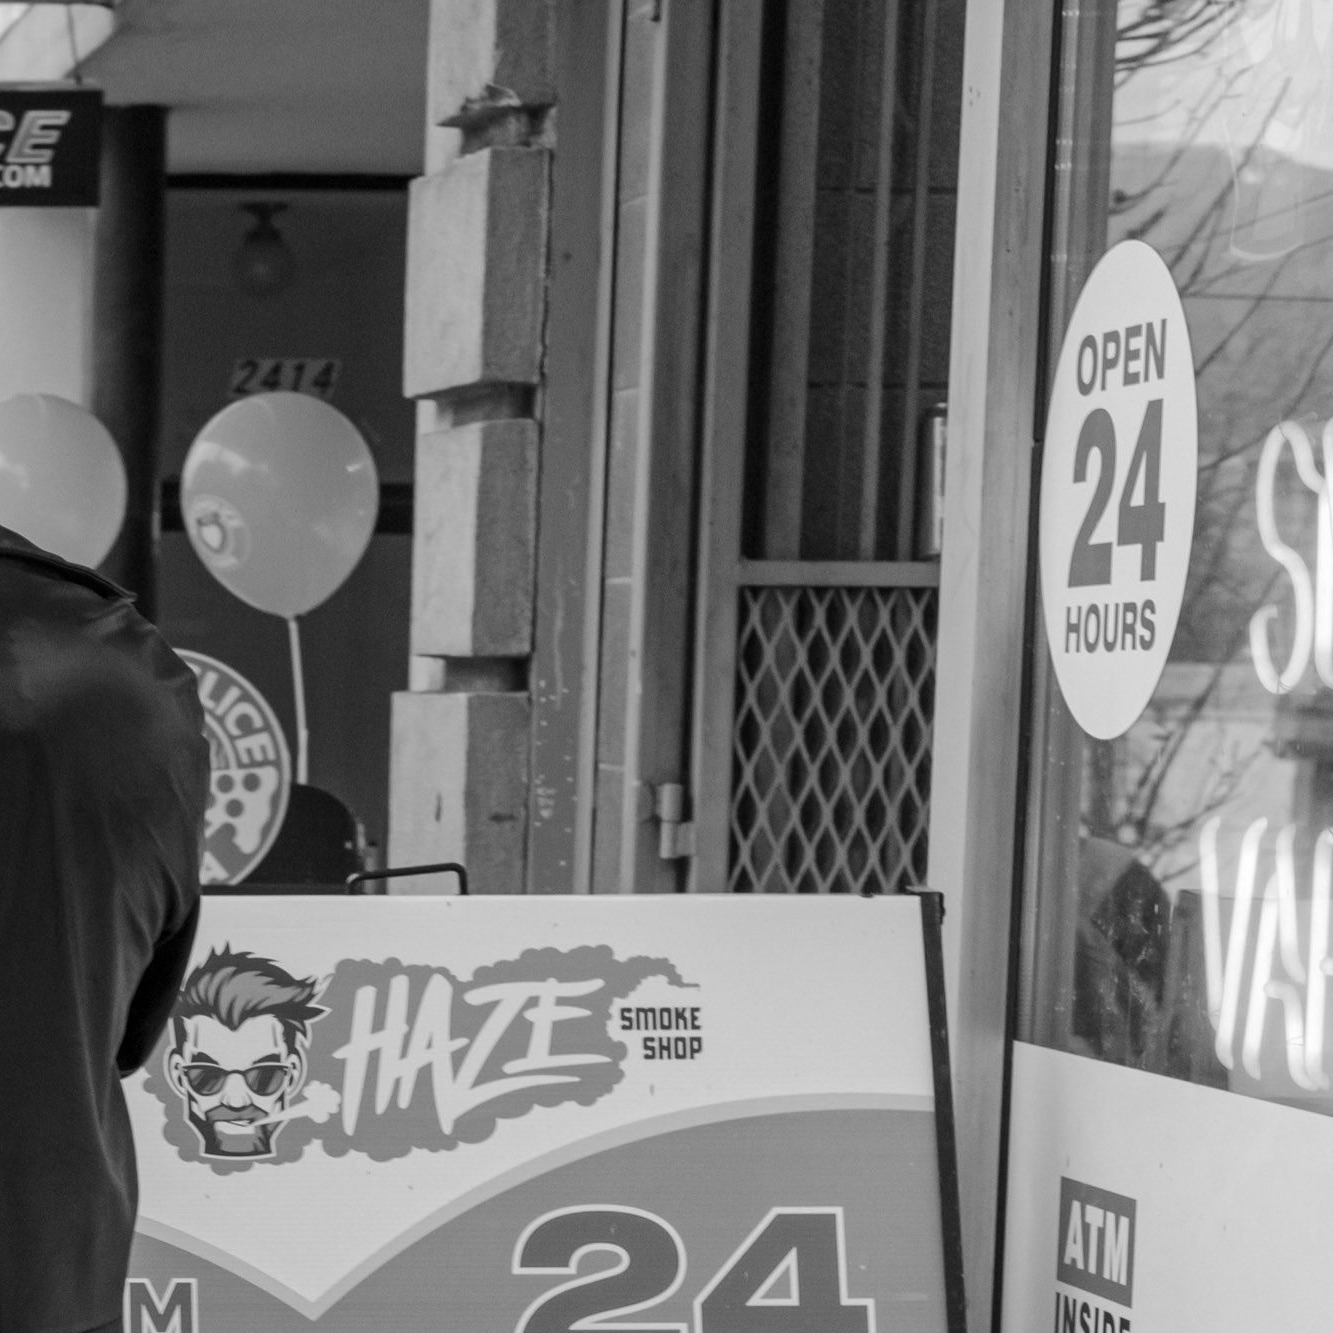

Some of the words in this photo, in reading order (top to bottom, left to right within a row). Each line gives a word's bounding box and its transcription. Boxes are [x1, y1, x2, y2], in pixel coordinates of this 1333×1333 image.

[232, 358, 336, 395] 2414
[1076, 318, 1167, 397] OPEN
[1067, 397, 1166, 589] 24
[1064, 597, 1156, 654] HOURS
[186, 661, 278, 767] LICE
[332, 973, 613, 1136] HAZE
[620, 1006, 702, 1031] SMOKE
[642, 1036, 703, 1060] SHOP
[1063, 1199, 1130, 1286] ATM
